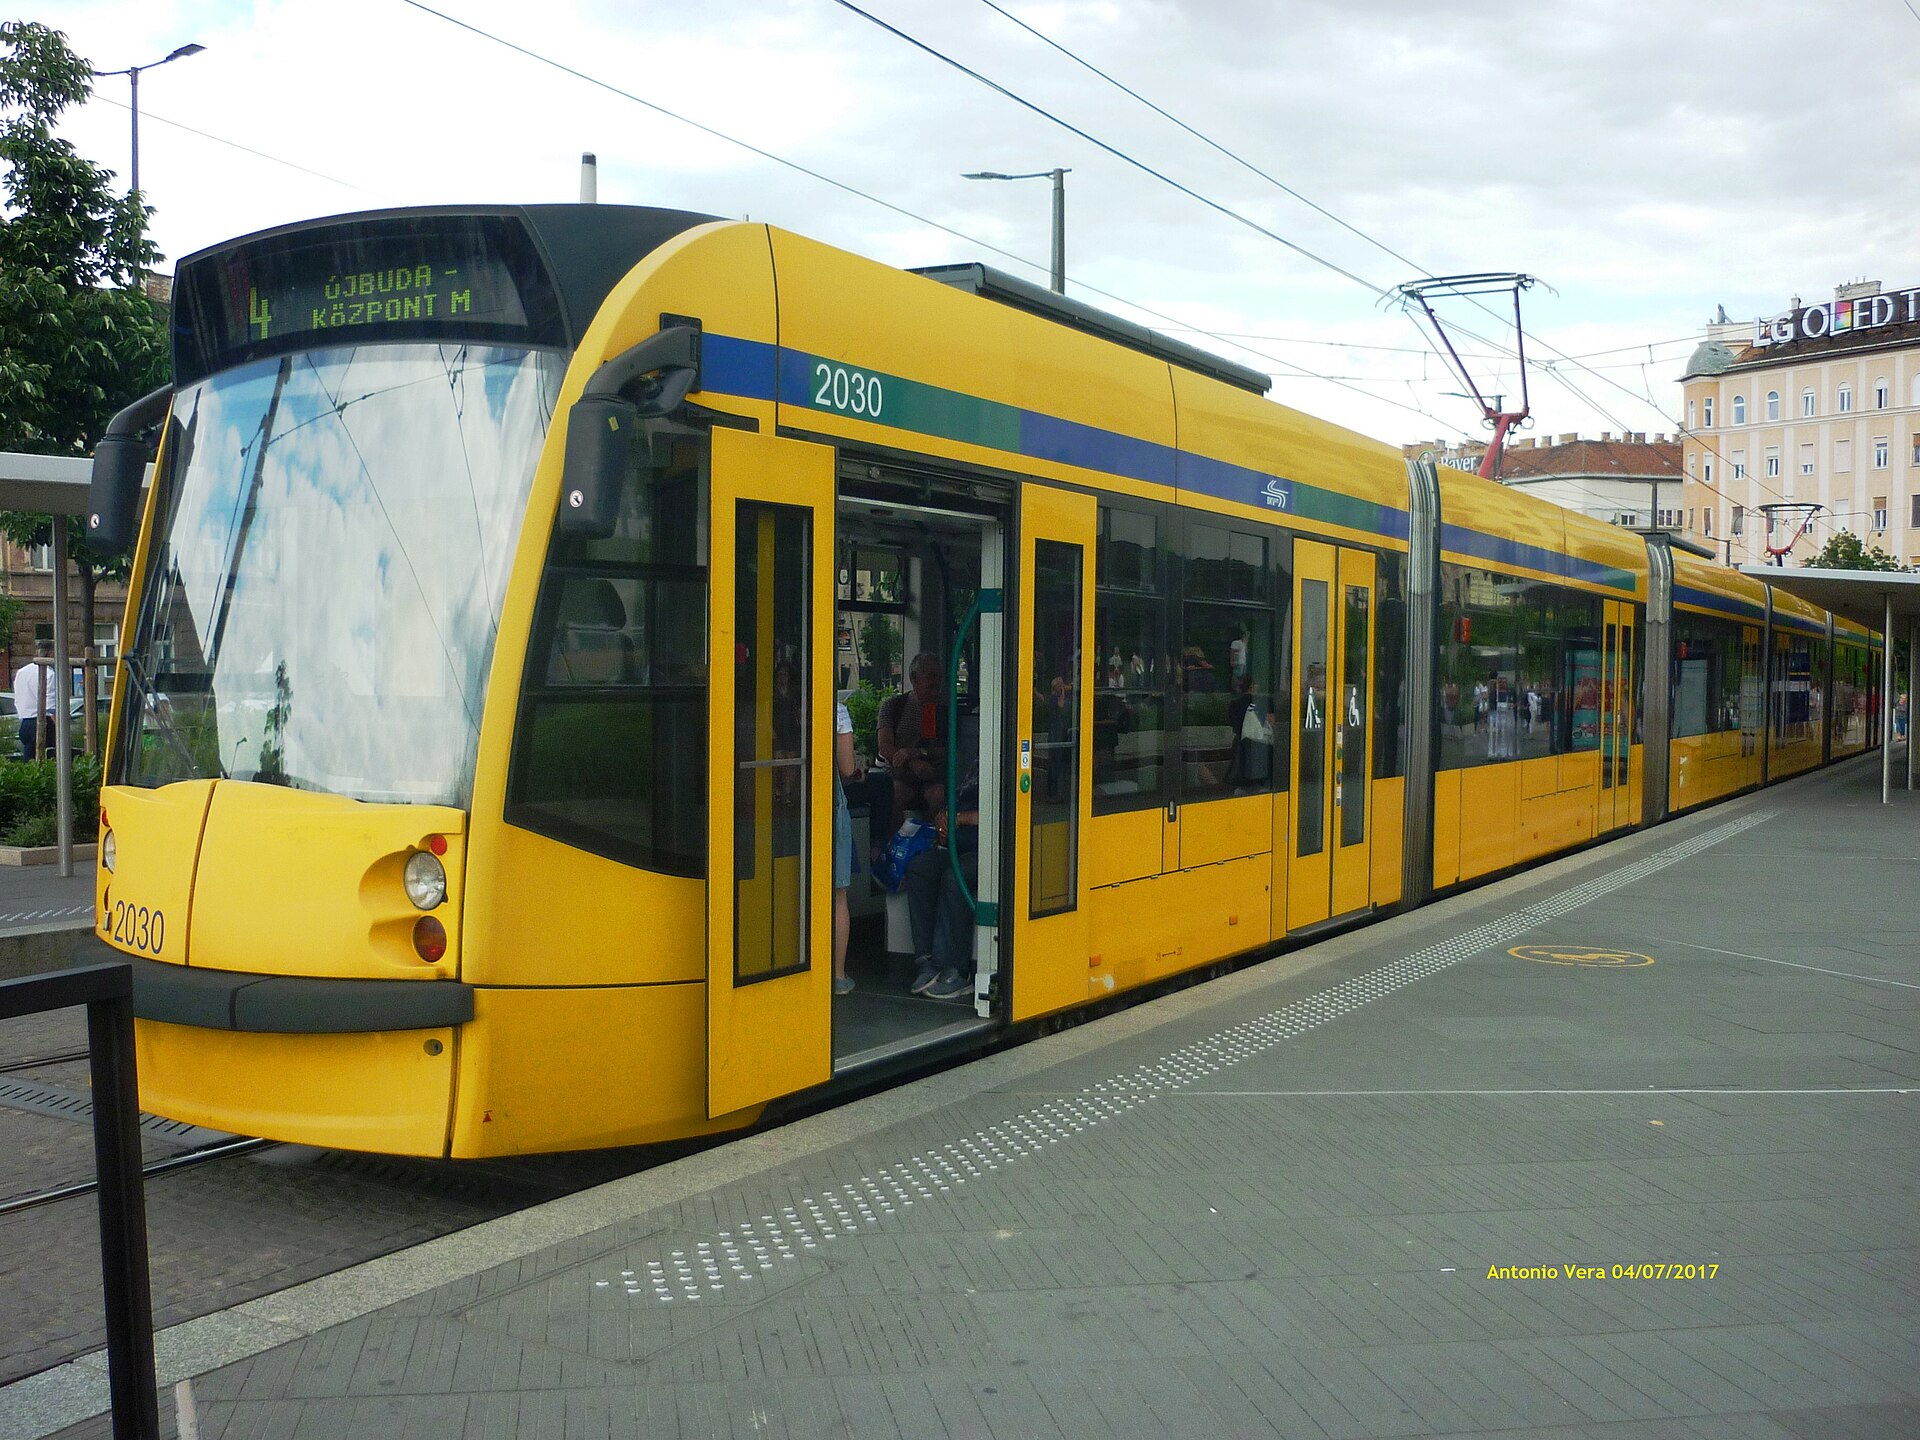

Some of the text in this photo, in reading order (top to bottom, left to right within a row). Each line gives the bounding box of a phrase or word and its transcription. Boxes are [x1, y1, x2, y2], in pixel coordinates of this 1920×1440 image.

[325, 265, 431, 300] ÚJBUDA
[249, 287, 272, 340] 4
[312, 289, 471, 330] KÖZPONT M
[1752, 309, 1796, 348] LG
[1801, 294, 1893, 338] OLED
[815, 363, 882, 417] 2030
[114, 900, 165, 954] 2030
